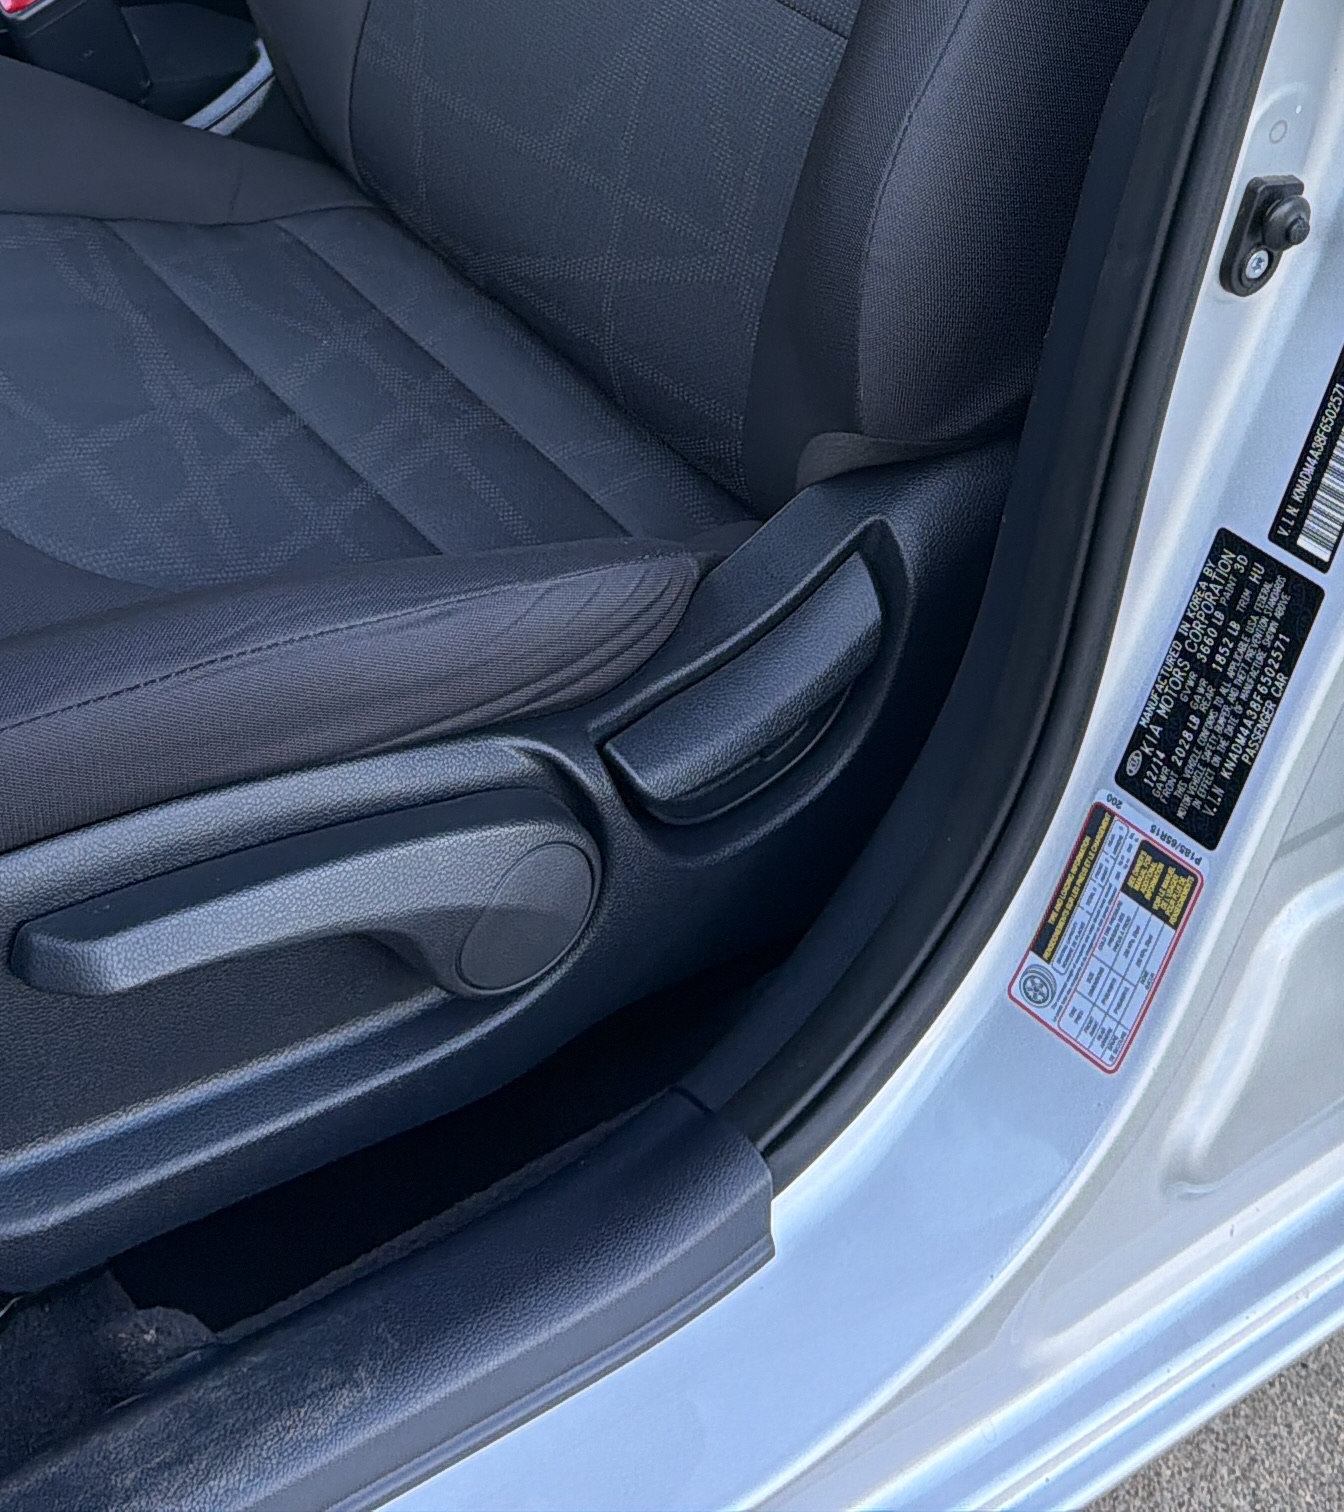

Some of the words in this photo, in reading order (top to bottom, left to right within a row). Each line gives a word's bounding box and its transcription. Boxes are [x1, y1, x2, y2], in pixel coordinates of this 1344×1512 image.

[1139, 640, 1182, 728] MANUFACTURED
[1178, 621, 1191, 636] IN
[1186, 582, 1208, 619] KOREA
[1203, 559, 1215, 577] BY
[1140, 725, 1163, 756] KIA
[1156, 658, 1190, 719] MOTORS
[1185, 548, 1236, 652] CORPORATION
[1180, 671, 1198, 702] GVWR
[1197, 628, 1218, 663] 3660
[1212, 611, 1225, 625] LB
[1220, 574, 1237, 606] PAINT
[1234, 555, 1248, 573] 3D
[1212, 637, 1234, 672] 1852
[1227, 621, 1240, 636] LB
[1236, 588, 1252, 612] TRIM
[1249, 562, 1265, 584] HU
[1173, 780, 1187, 798] THIS
[1183, 747, 1202, 778] VEHICLE
[1197, 709, 1218, 746] CONFORMS
[1213, 696, 1224, 707] TO
[1219, 682, 1232, 696] ALL
[1227, 634, 1250, 679] APPLICABLE
[1254, 582, 1273, 612] FEDERAL
[1177, 794, 1192, 819] MOTOR
[1187, 763, 1206, 795] VEHICLE
[1233, 663, 1249, 686] THEFT
[1245, 616, 1269, 663] PREVENTION
[1264, 575, 1286, 617] STANDARDS
[1190, 678, 1208, 710] GAWR
[1192, 798, 1202, 810] IN
[1197, 767, 1215, 799] EFFECT
[1211, 755, 1222, 767] ON
[1217, 737, 1230, 753] THE
[1224, 715, 1239, 737] DATE
[1240, 649, 1267, 701] MANUFACTURE
[1262, 621, 1279, 647] SHOWN
[1274, 592, 1291, 620] ABOVE
[1199, 685, 1216, 714] REAR
[1220, 634, 1290, 779] KNADM4A38F6502571
[1241, 700, 1276, 765] PASSENGER
[1271, 673, 1288, 697] CAR
[1144, 750, 1165, 787] 12/14
[1152, 766, 1170, 797] GAWR
[1160, 771, 1178, 804] FRONT
[1171, 730, 1193, 767] 2028
[1187, 715, 1200, 730] LB
[1106, 793, 1123, 809] 200
